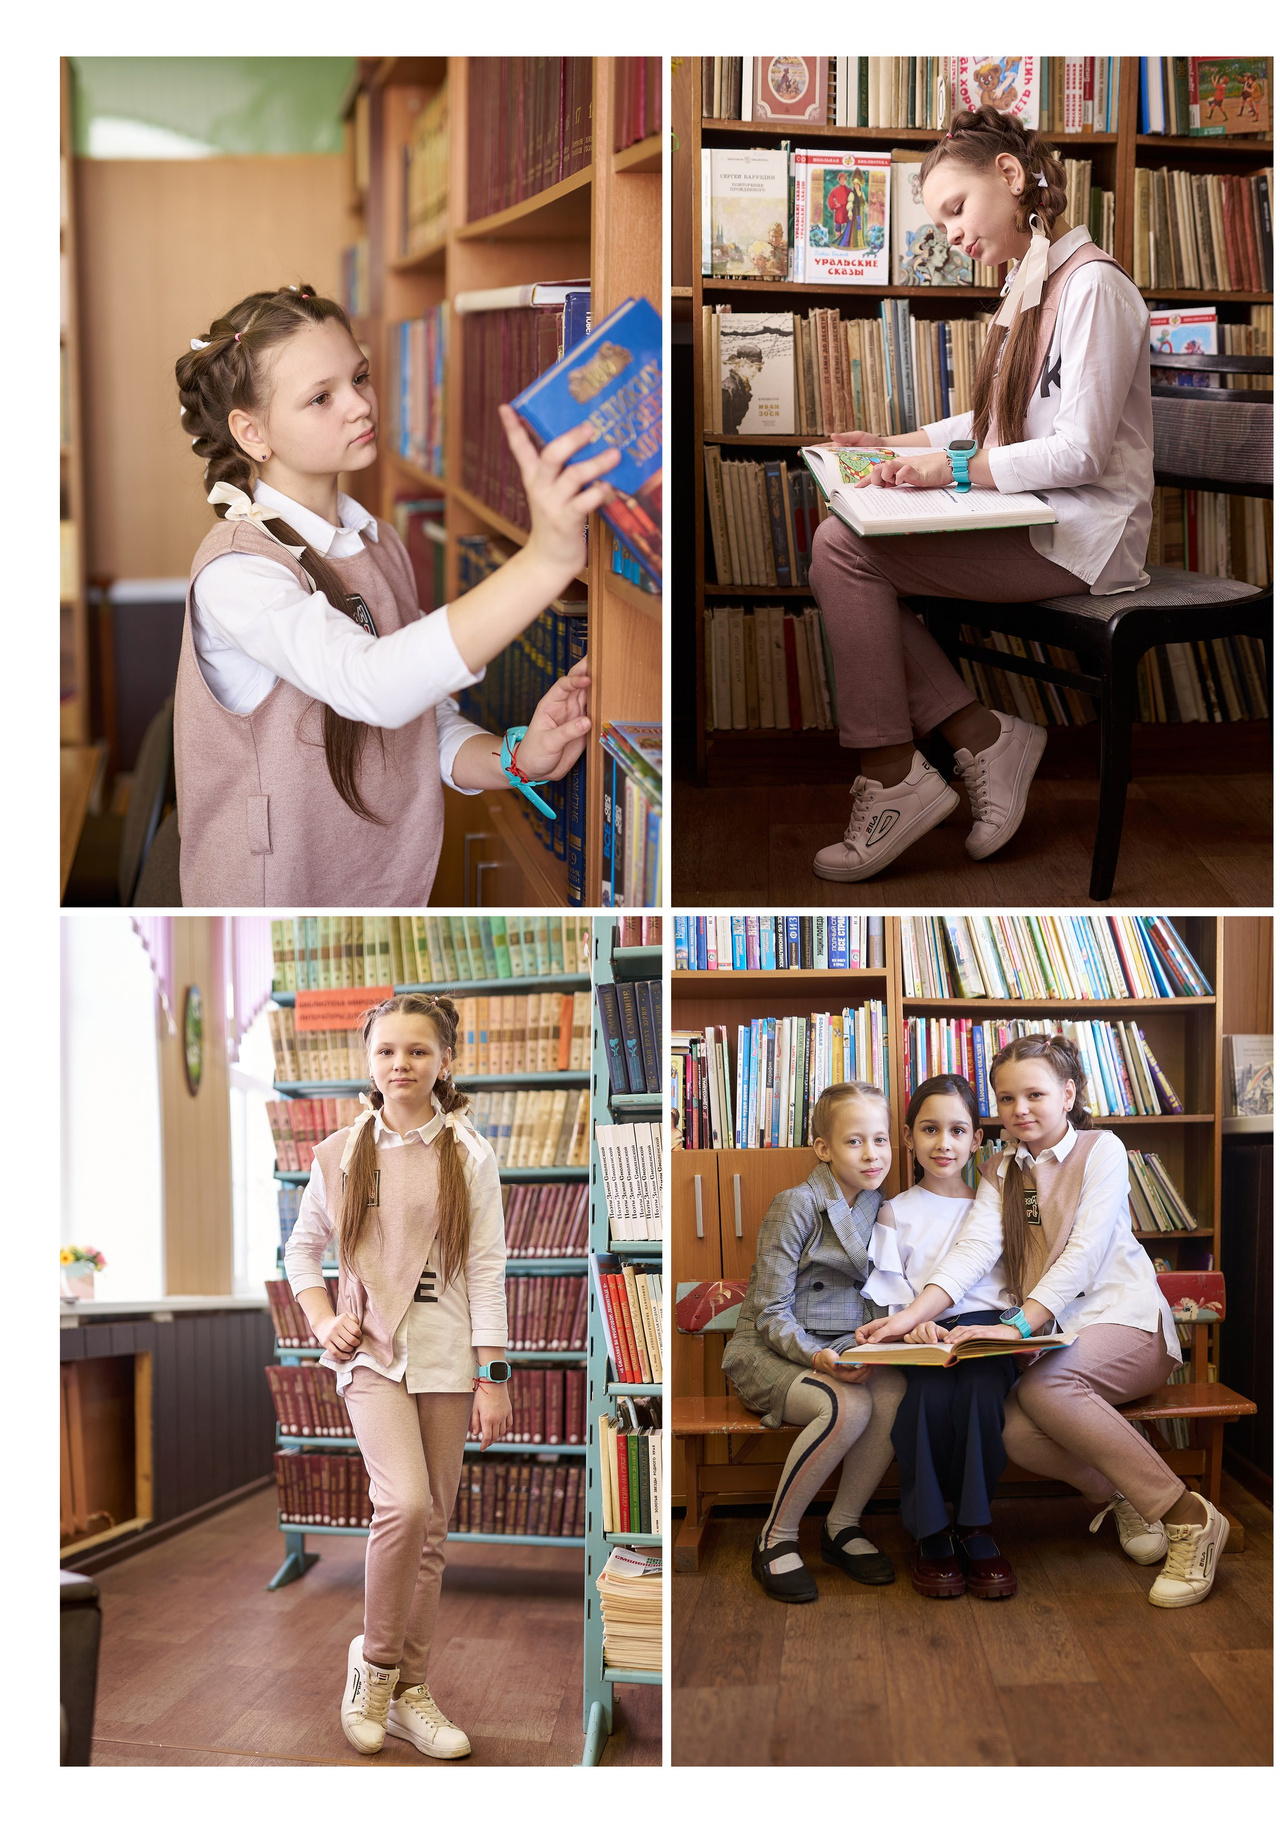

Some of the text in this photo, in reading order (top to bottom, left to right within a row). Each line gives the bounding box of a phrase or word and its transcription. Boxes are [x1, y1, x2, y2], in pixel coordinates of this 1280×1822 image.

[960, 57, 969, 75] ак
[571, 763, 579, 824] ЭНЦИКЛО
[838, 938, 846, 951] ВСЕ
[622, 990, 635, 1035] СМОЛЯНЕ
